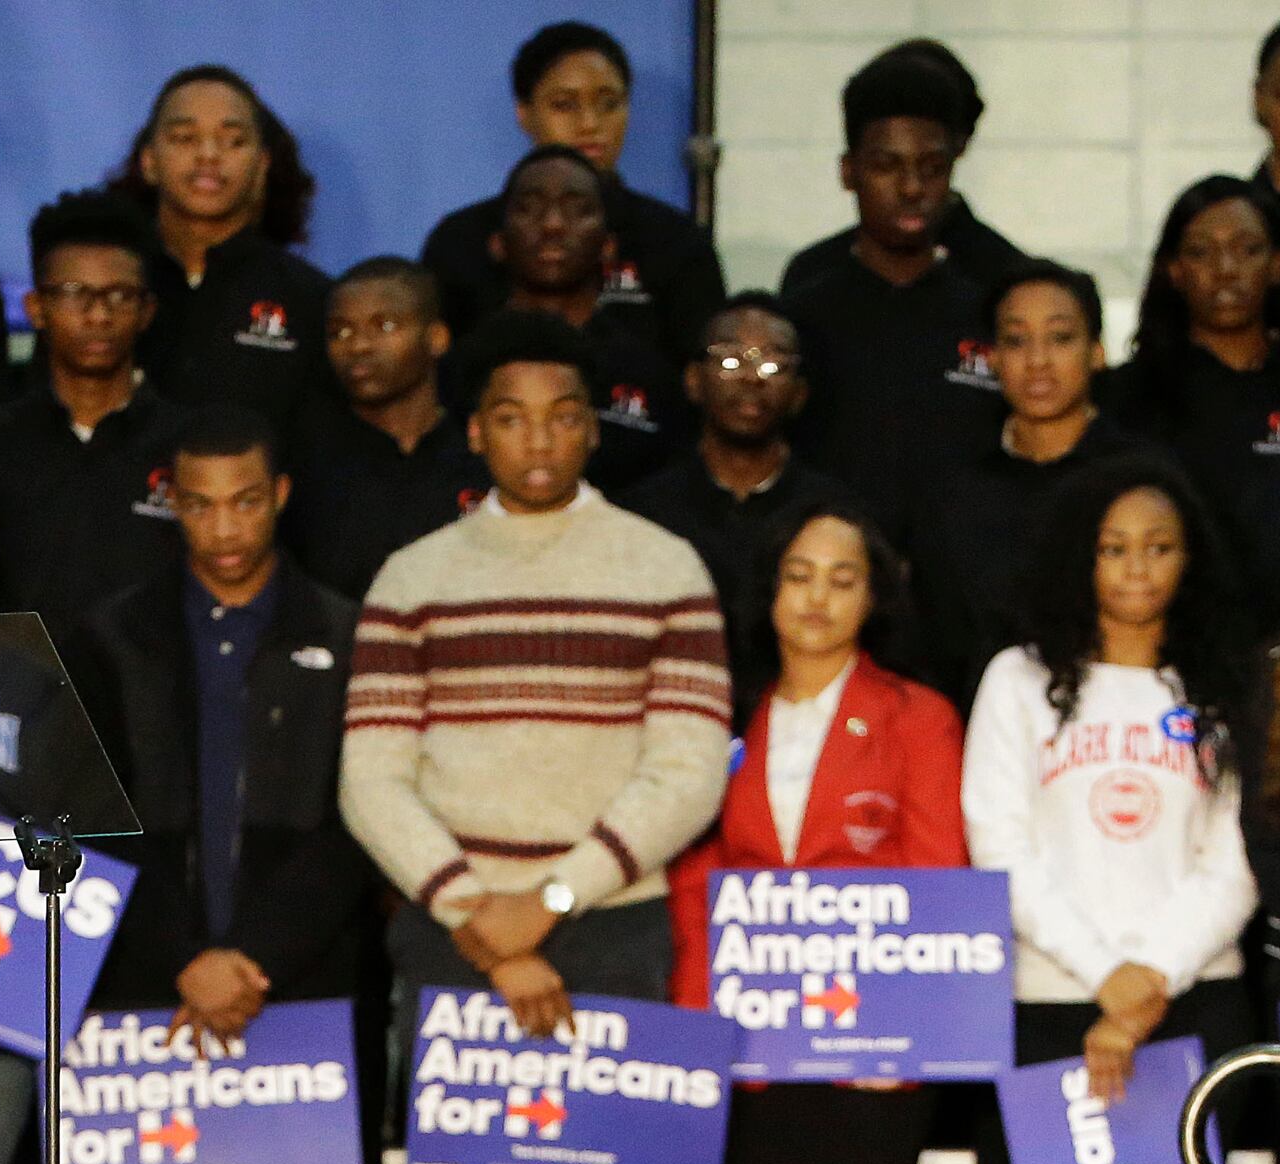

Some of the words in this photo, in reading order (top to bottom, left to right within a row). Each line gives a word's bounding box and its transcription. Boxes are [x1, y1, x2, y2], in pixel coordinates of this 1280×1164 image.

[711, 871, 910, 925] African
[711, 922, 1006, 974] Americans
[715, 975, 799, 1030] for
[416, 1037, 722, 1108] Americans
[415, 1083, 503, 1136] for
